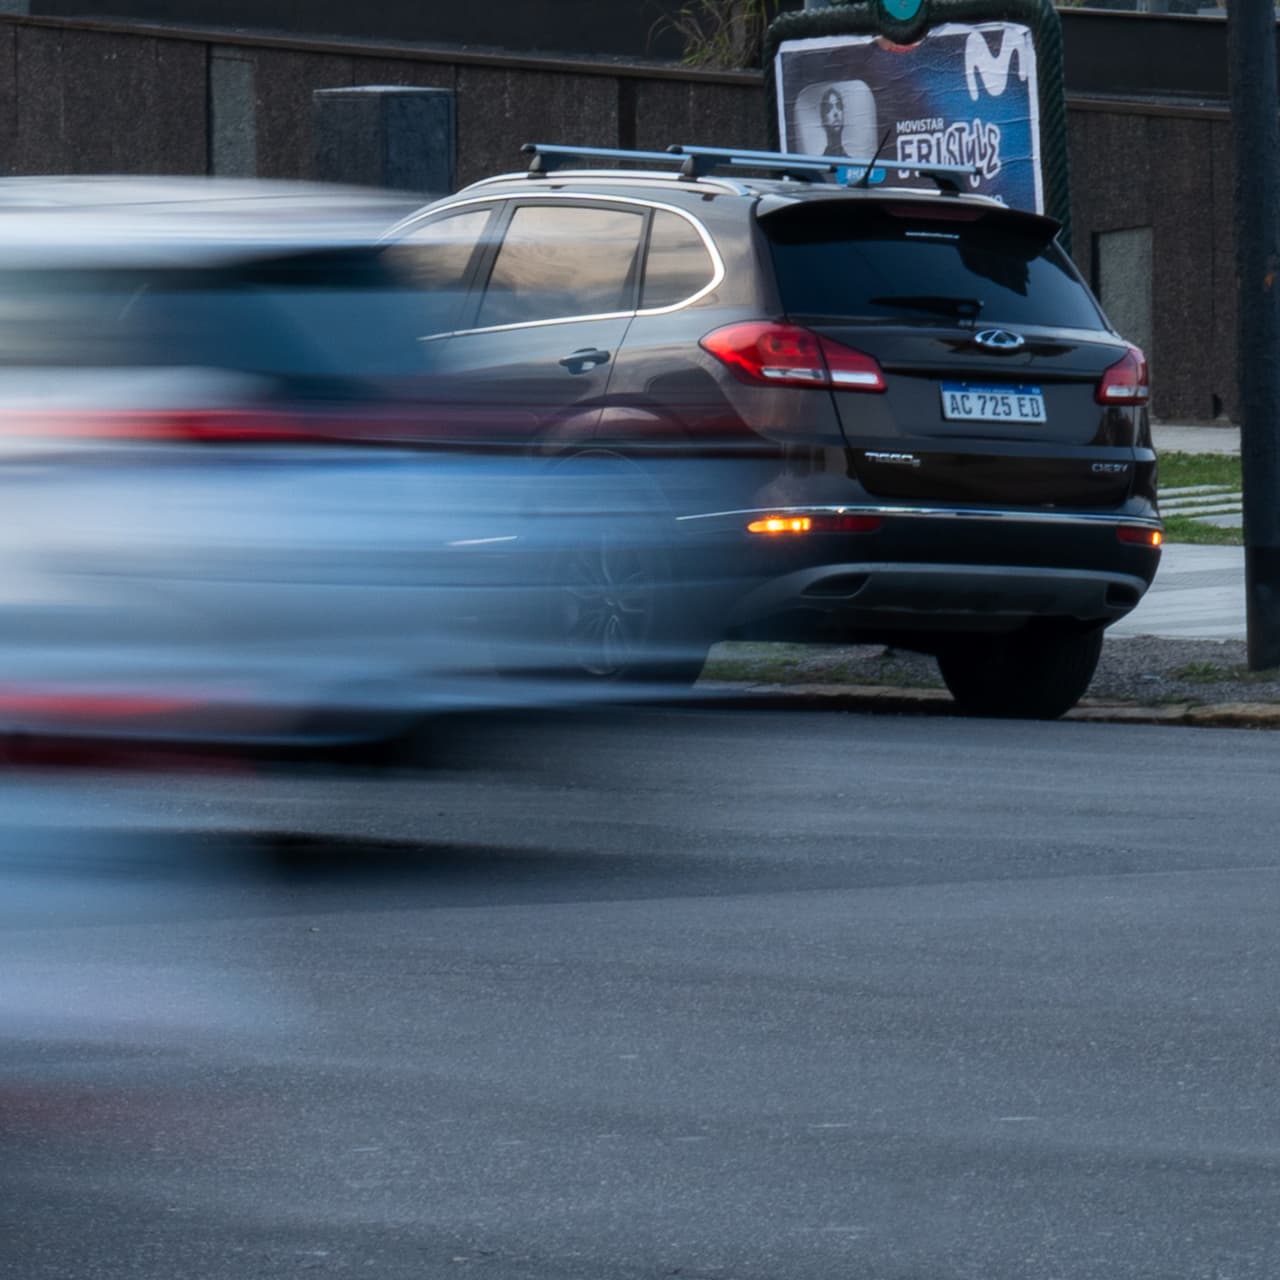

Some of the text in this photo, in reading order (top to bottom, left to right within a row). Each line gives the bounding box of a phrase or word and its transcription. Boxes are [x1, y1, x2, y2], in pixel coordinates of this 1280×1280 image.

[897, 118, 944, 134] MOVISTAR
[950, 394, 1041, 418] AC 725 ED
